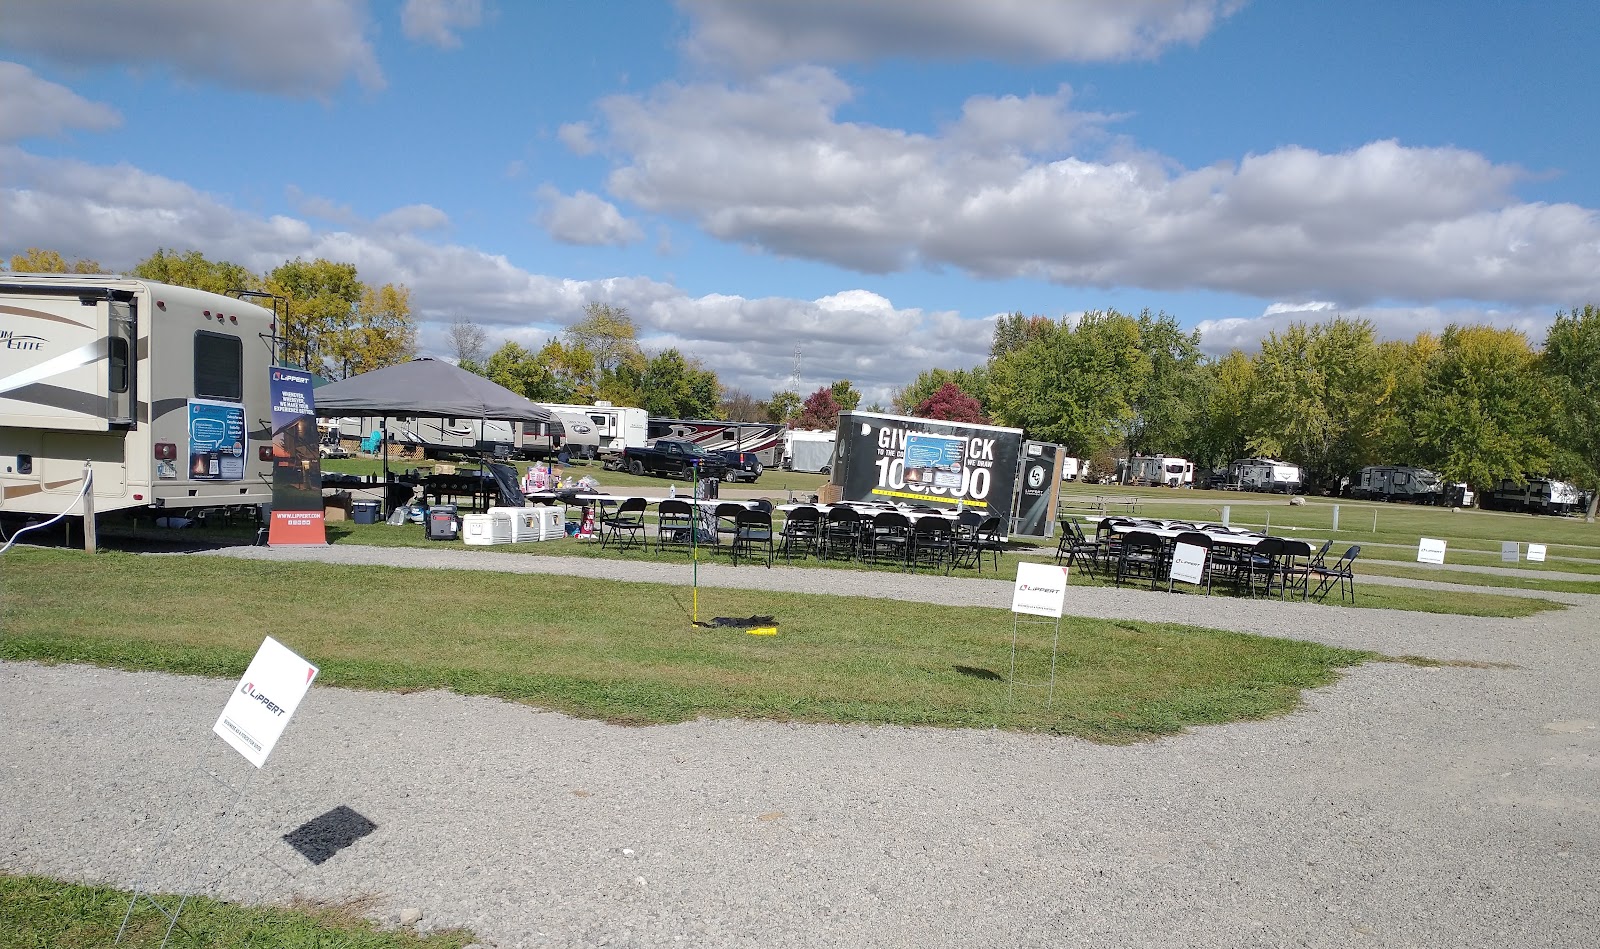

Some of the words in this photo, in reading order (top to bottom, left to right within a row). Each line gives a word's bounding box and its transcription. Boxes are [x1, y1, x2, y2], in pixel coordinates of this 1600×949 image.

[7, 339, 44, 351] ELITE
[877, 448, 885, 456] TO
[967, 459, 976, 467] WE
[977, 460, 993, 468] DRAW
